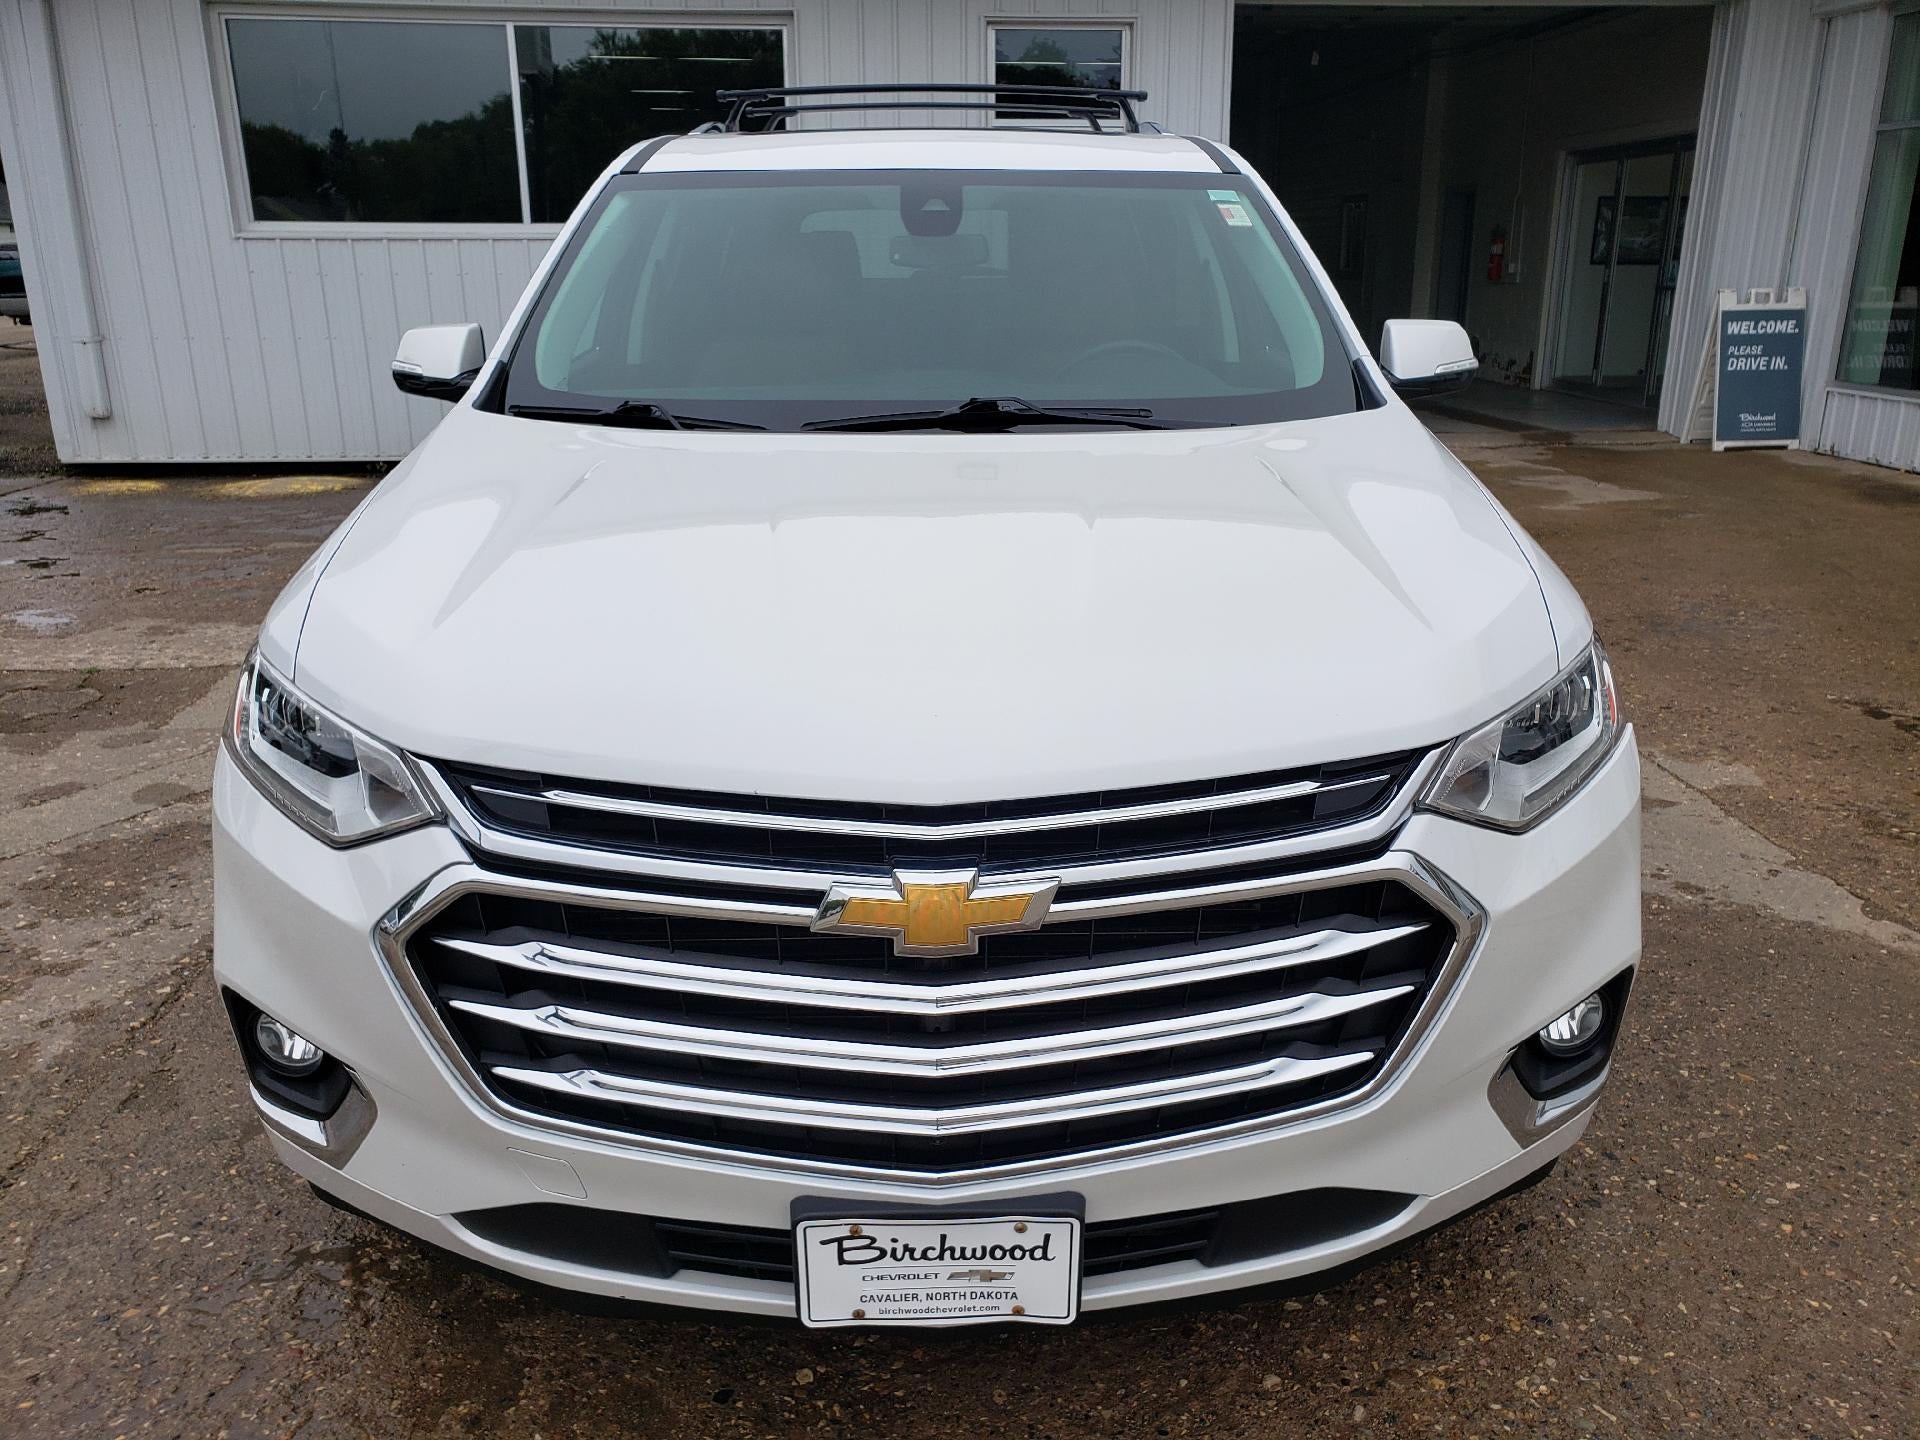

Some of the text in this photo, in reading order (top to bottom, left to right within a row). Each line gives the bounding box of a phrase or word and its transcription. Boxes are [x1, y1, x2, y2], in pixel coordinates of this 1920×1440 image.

[1727, 320, 1799, 334] WELCOME.
[1728, 345, 1763, 355] PLEASE
[1727, 356, 1788, 371] DRIVE IN.
[819, 1233, 1056, 1266] Birchwood
[862, 1272, 940, 1282] CHEVROLET
[860, 1290, 1018, 1303] CAVALIER, NORTH DAKOTA
[878, 1304, 1000, 1315] birchwoodchevrolet.com
